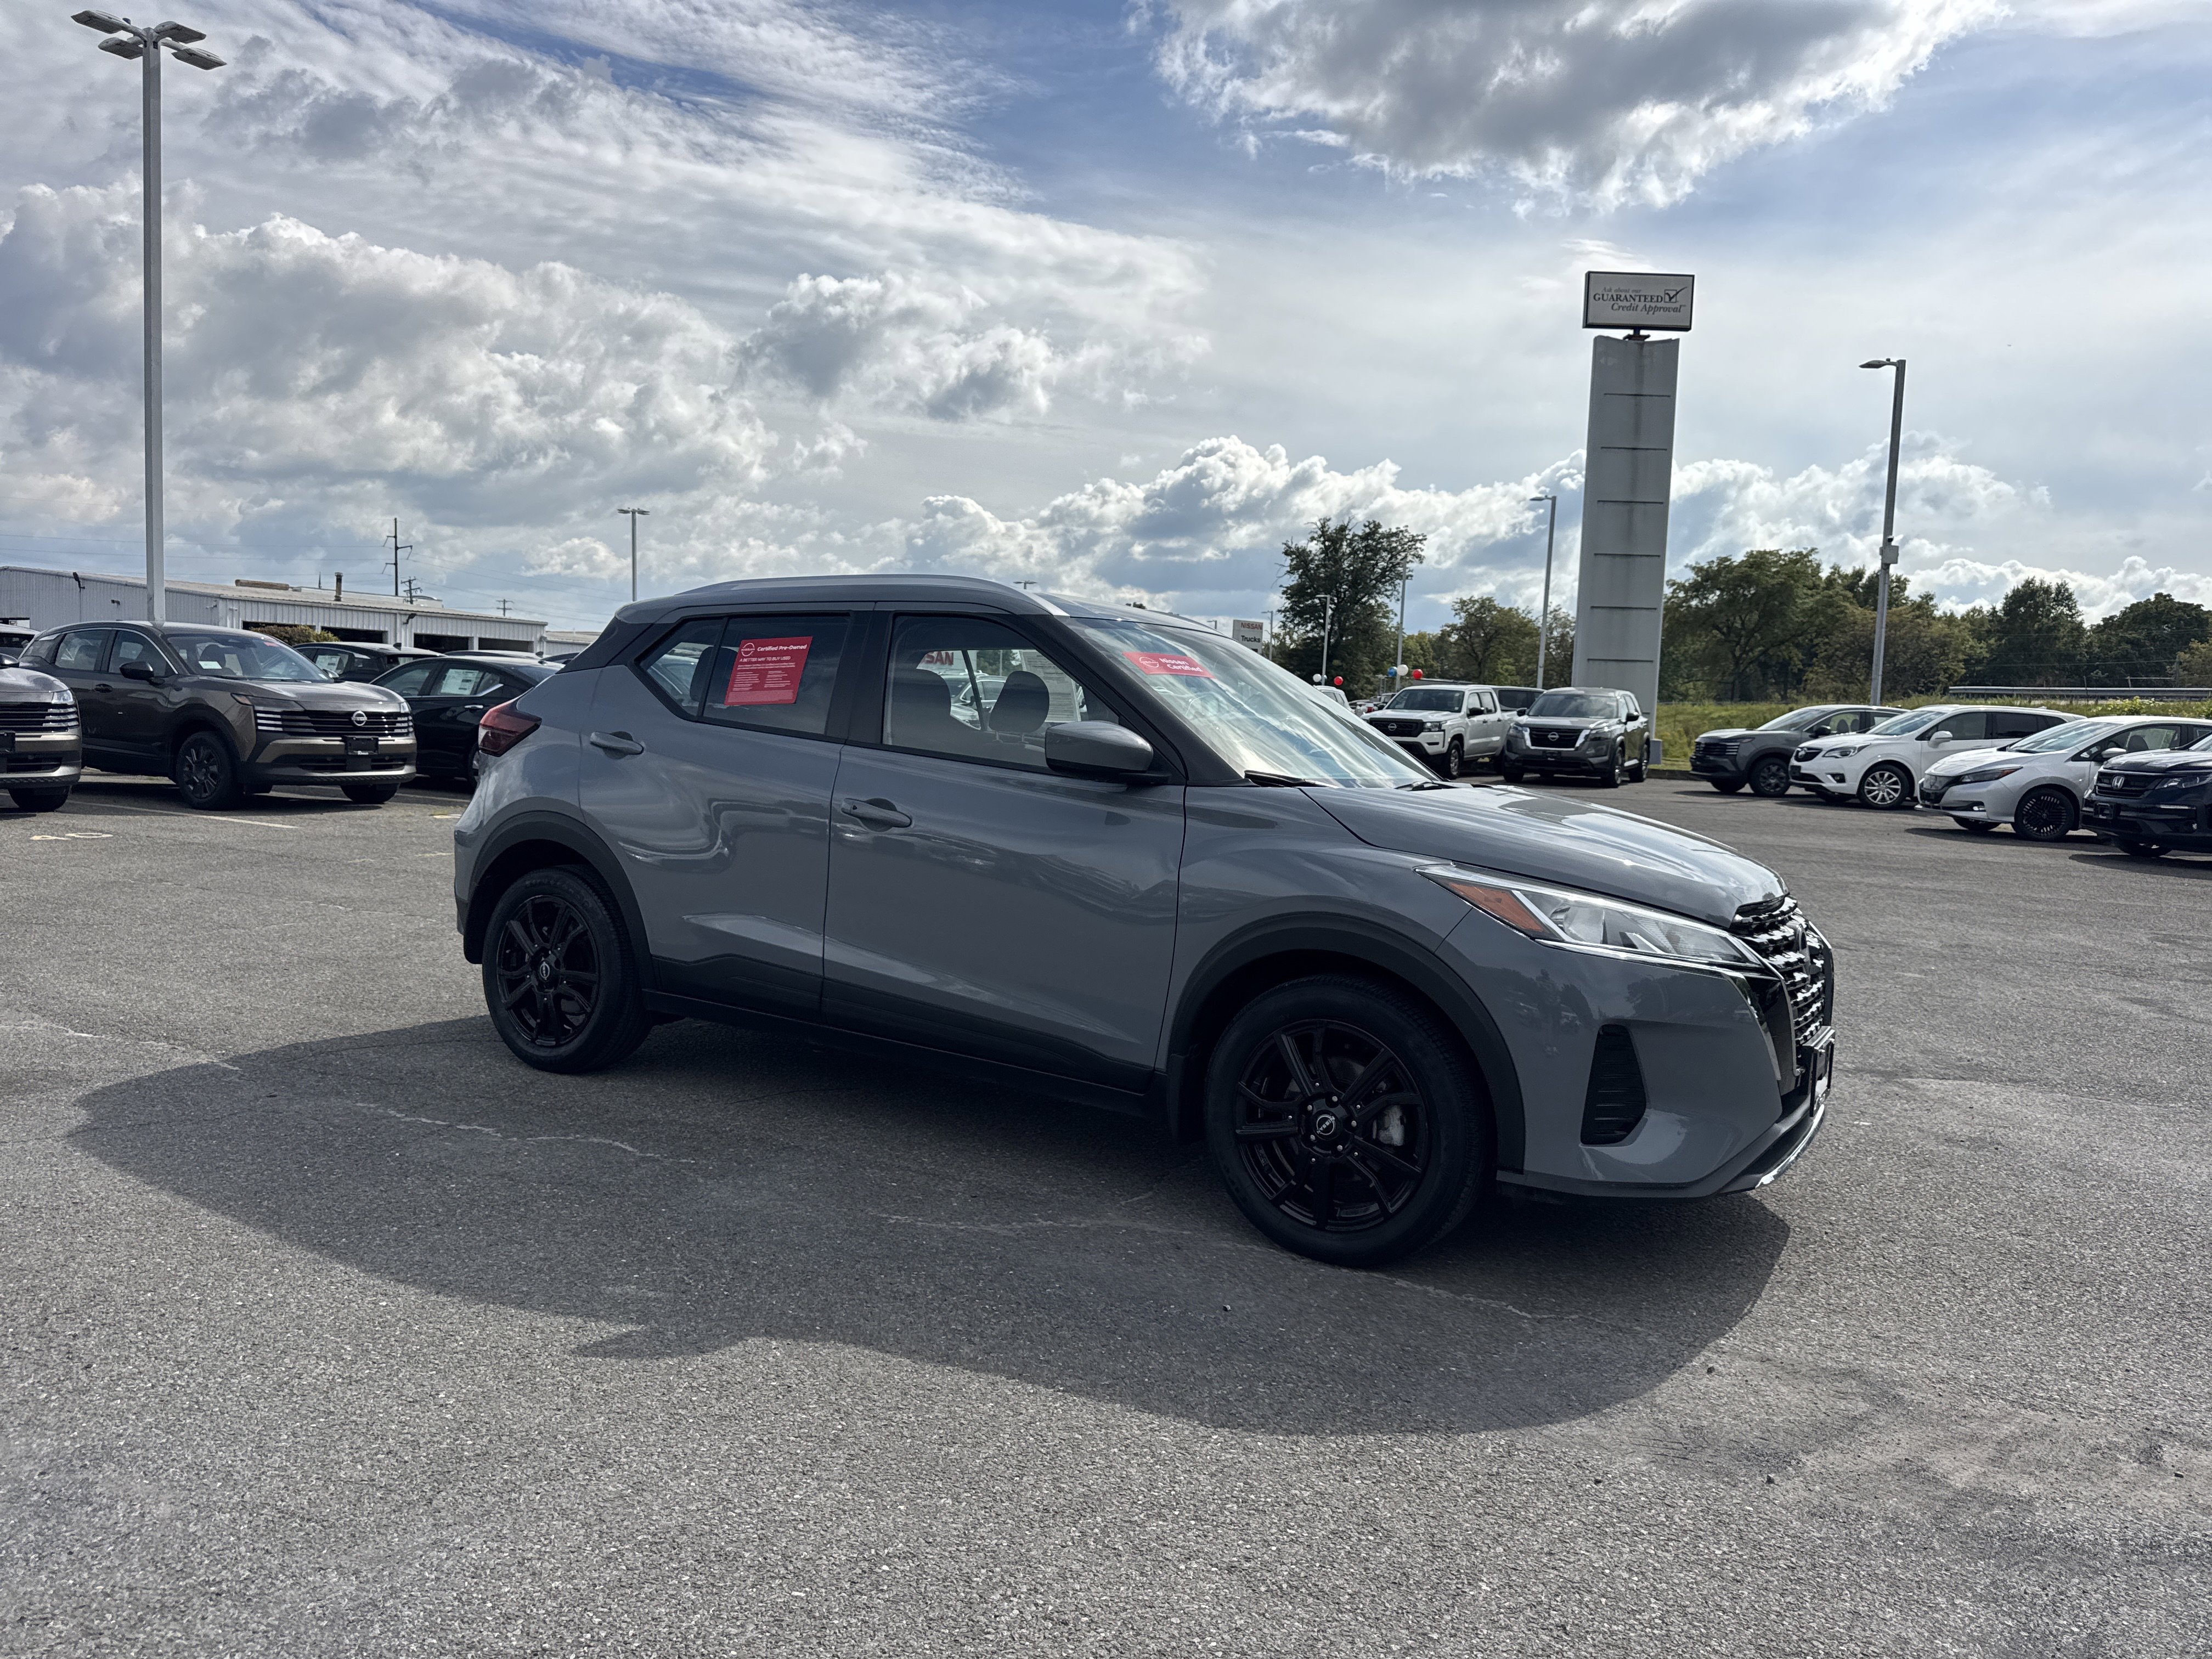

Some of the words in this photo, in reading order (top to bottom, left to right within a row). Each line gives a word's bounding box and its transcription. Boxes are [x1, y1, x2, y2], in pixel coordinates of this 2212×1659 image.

[1593, 293, 1663, 303] GUARANTEED
[1611, 303, 1638, 312] Credit
[1640, 304, 1682, 315] Approval
[922, 651, 954, 665] SAN
[1167, 664, 1203, 672] Certified
[1317, 1116, 1335, 1134] NISSAN
